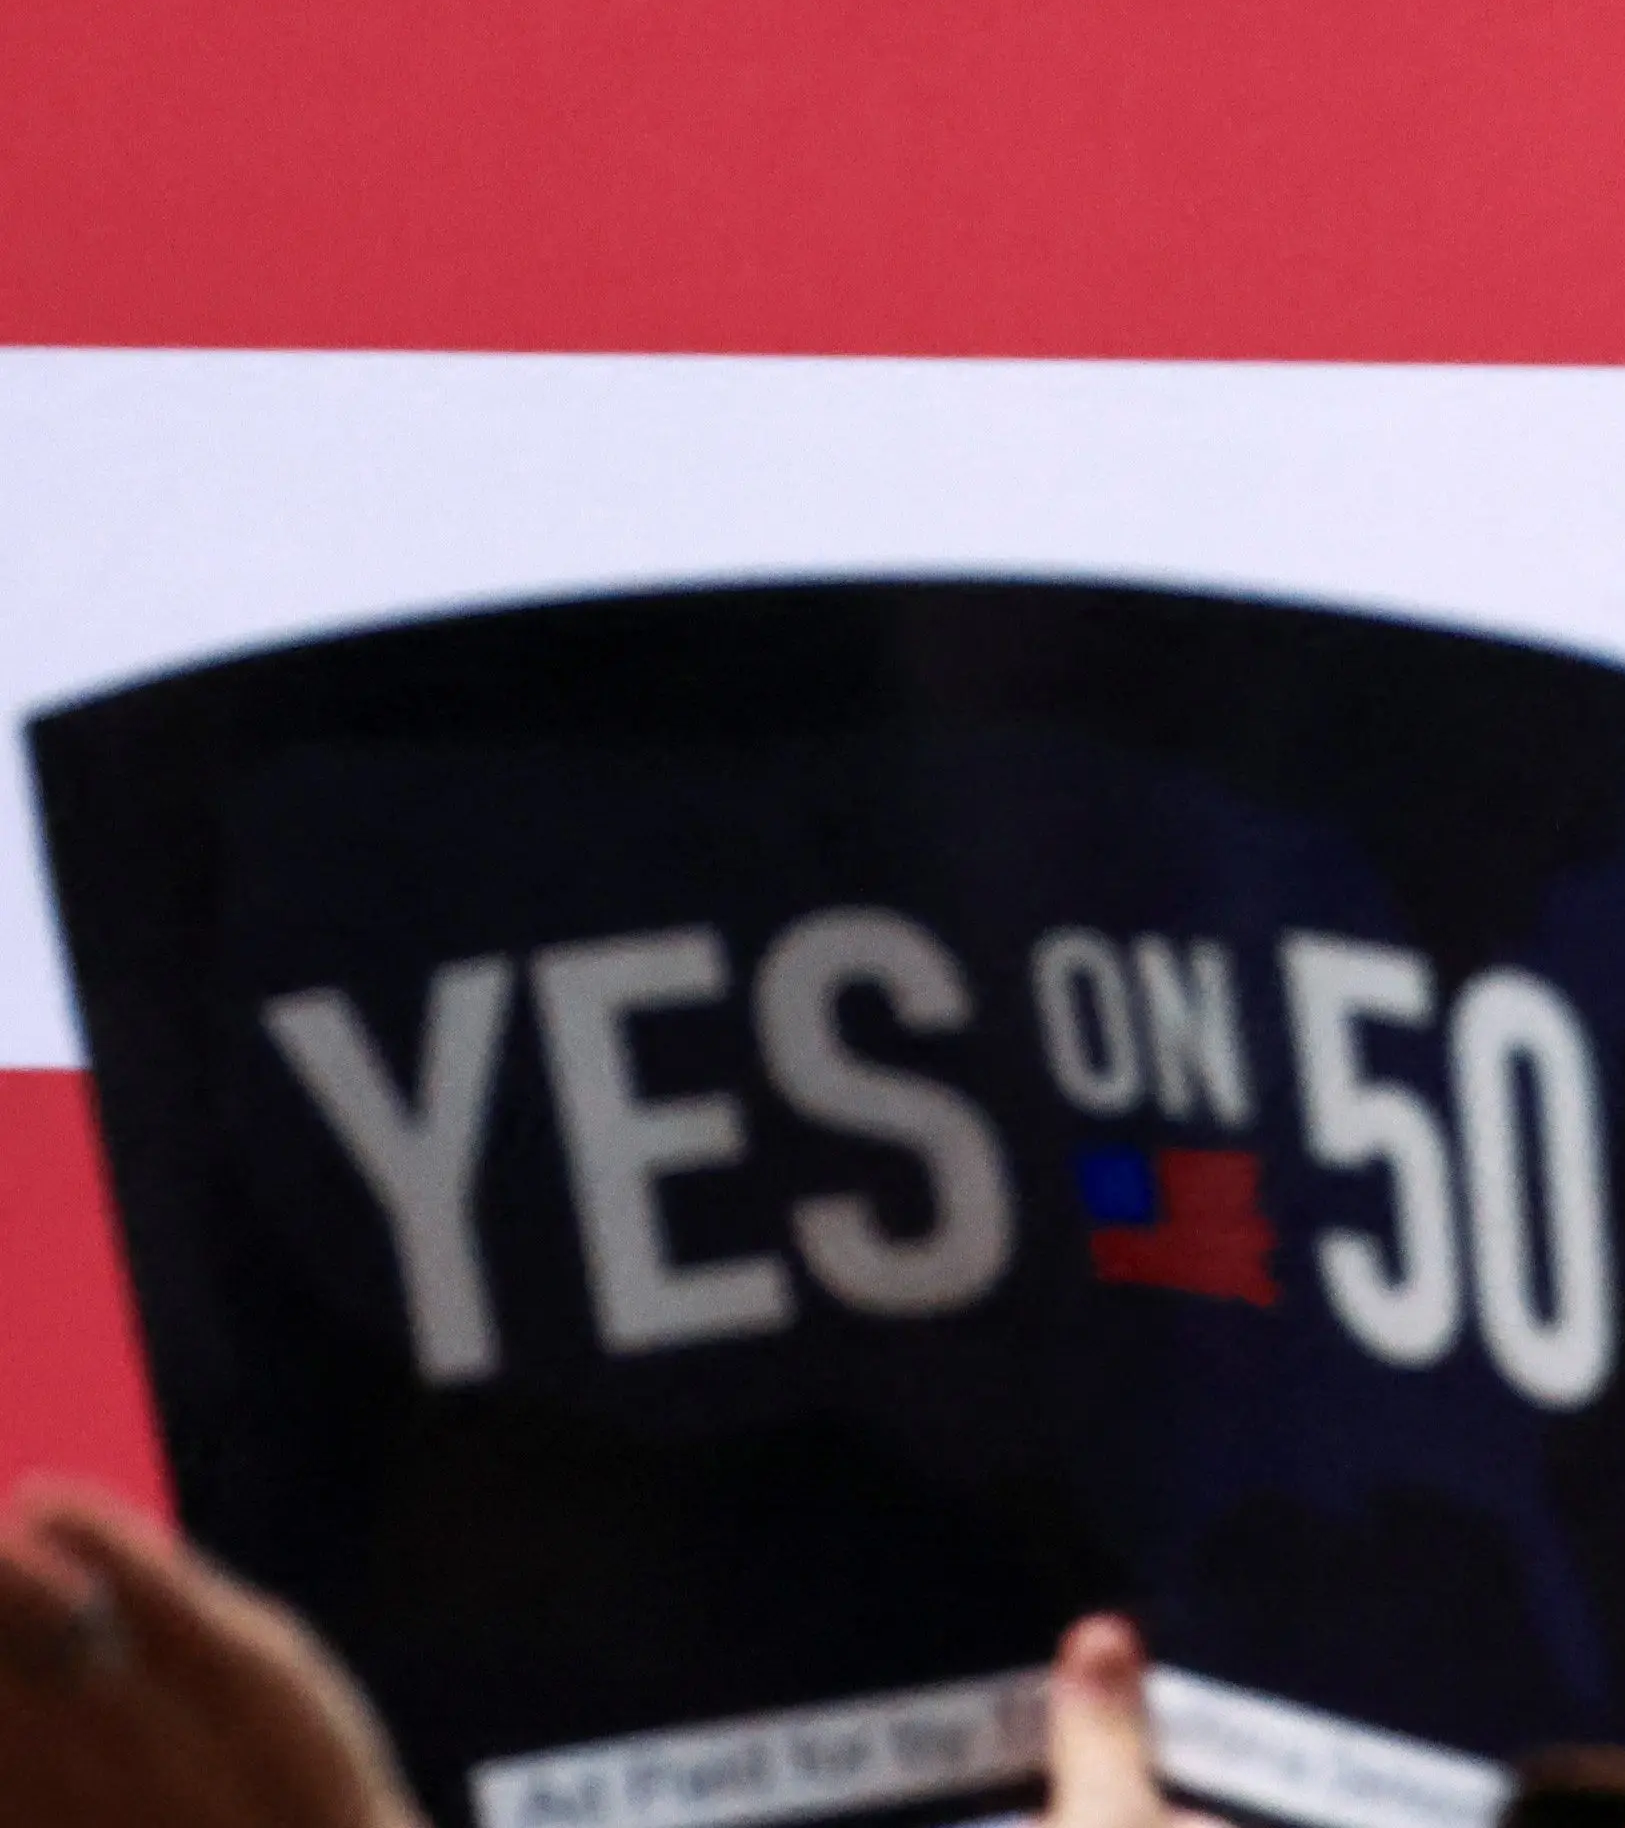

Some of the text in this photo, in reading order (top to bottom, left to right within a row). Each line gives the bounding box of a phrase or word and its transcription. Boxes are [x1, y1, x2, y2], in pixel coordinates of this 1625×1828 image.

[262, 905, 1618, 1410] YES ON 50
